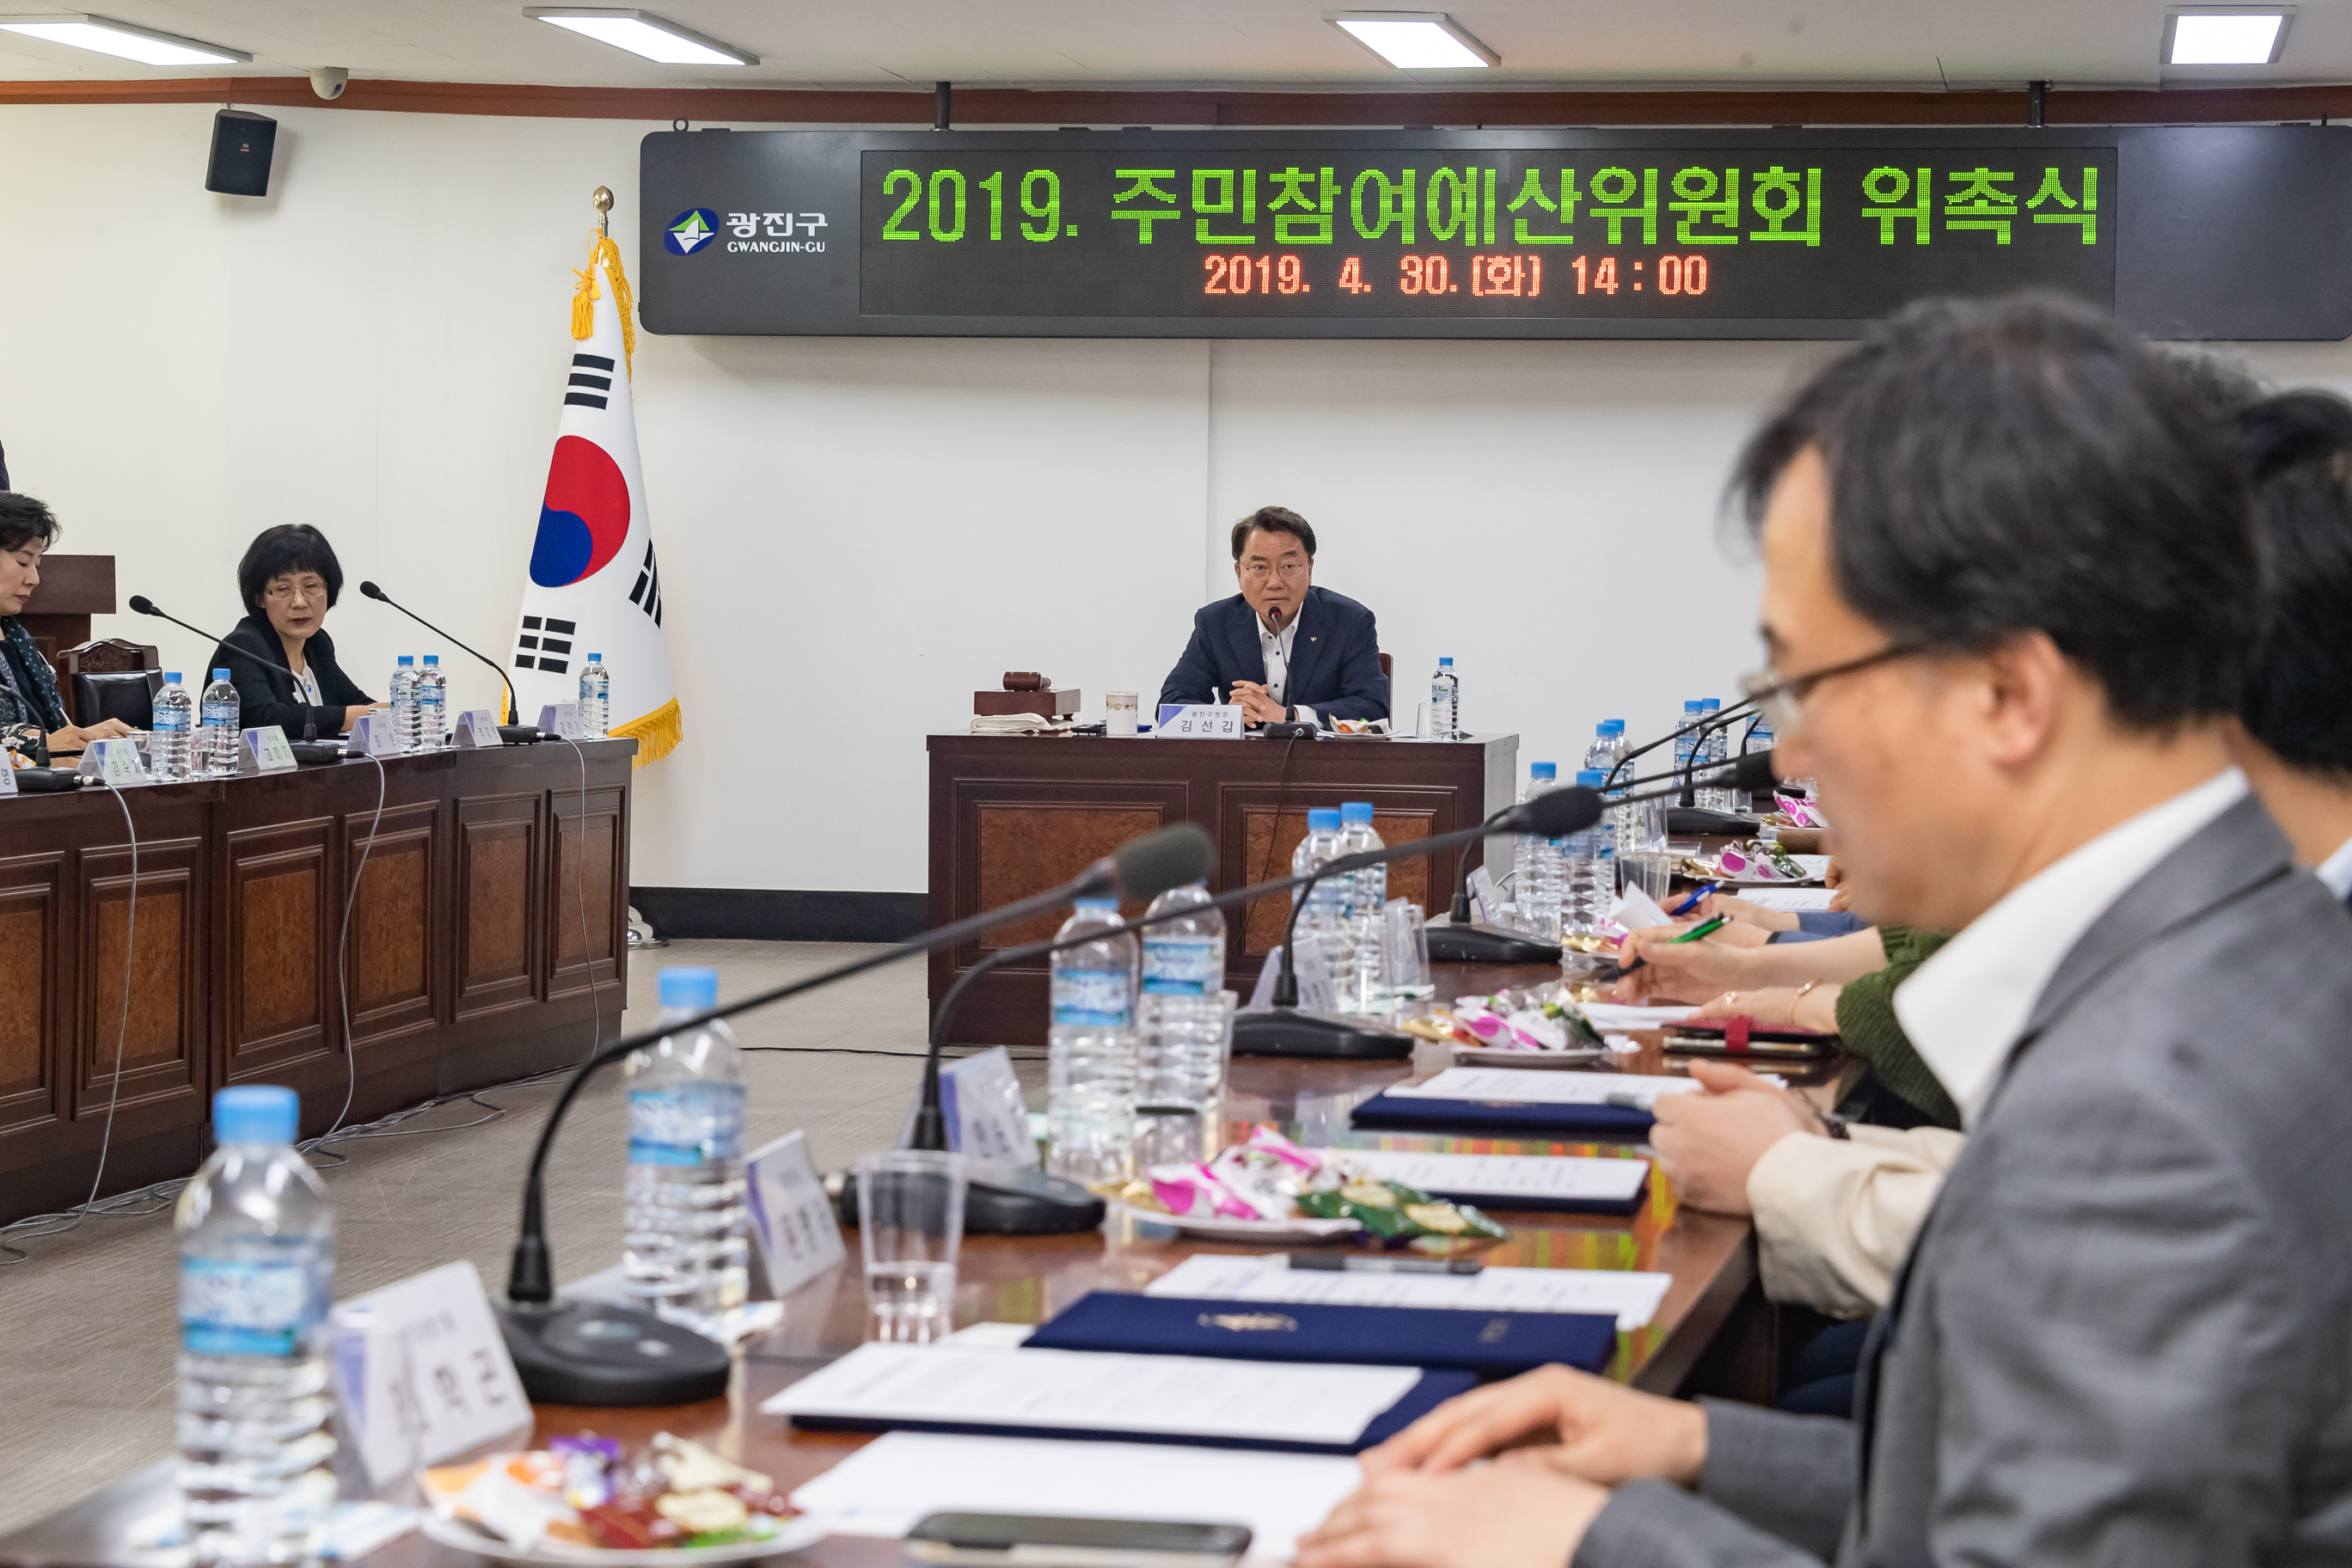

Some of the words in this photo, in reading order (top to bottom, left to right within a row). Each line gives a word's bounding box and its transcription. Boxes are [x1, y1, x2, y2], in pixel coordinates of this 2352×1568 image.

[883, 168, 1078, 244] 2019.
[1111, 166, 1822, 247] 주민참여예산위원회
[1861, 165, 2098, 245] 위촉식
[726, 212, 829, 238] 광진구
[726, 241, 826, 253] GWANGJIN-GU
[1204, 254, 1312, 296] 2019.
[1338, 256, 1373, 295] 4.
